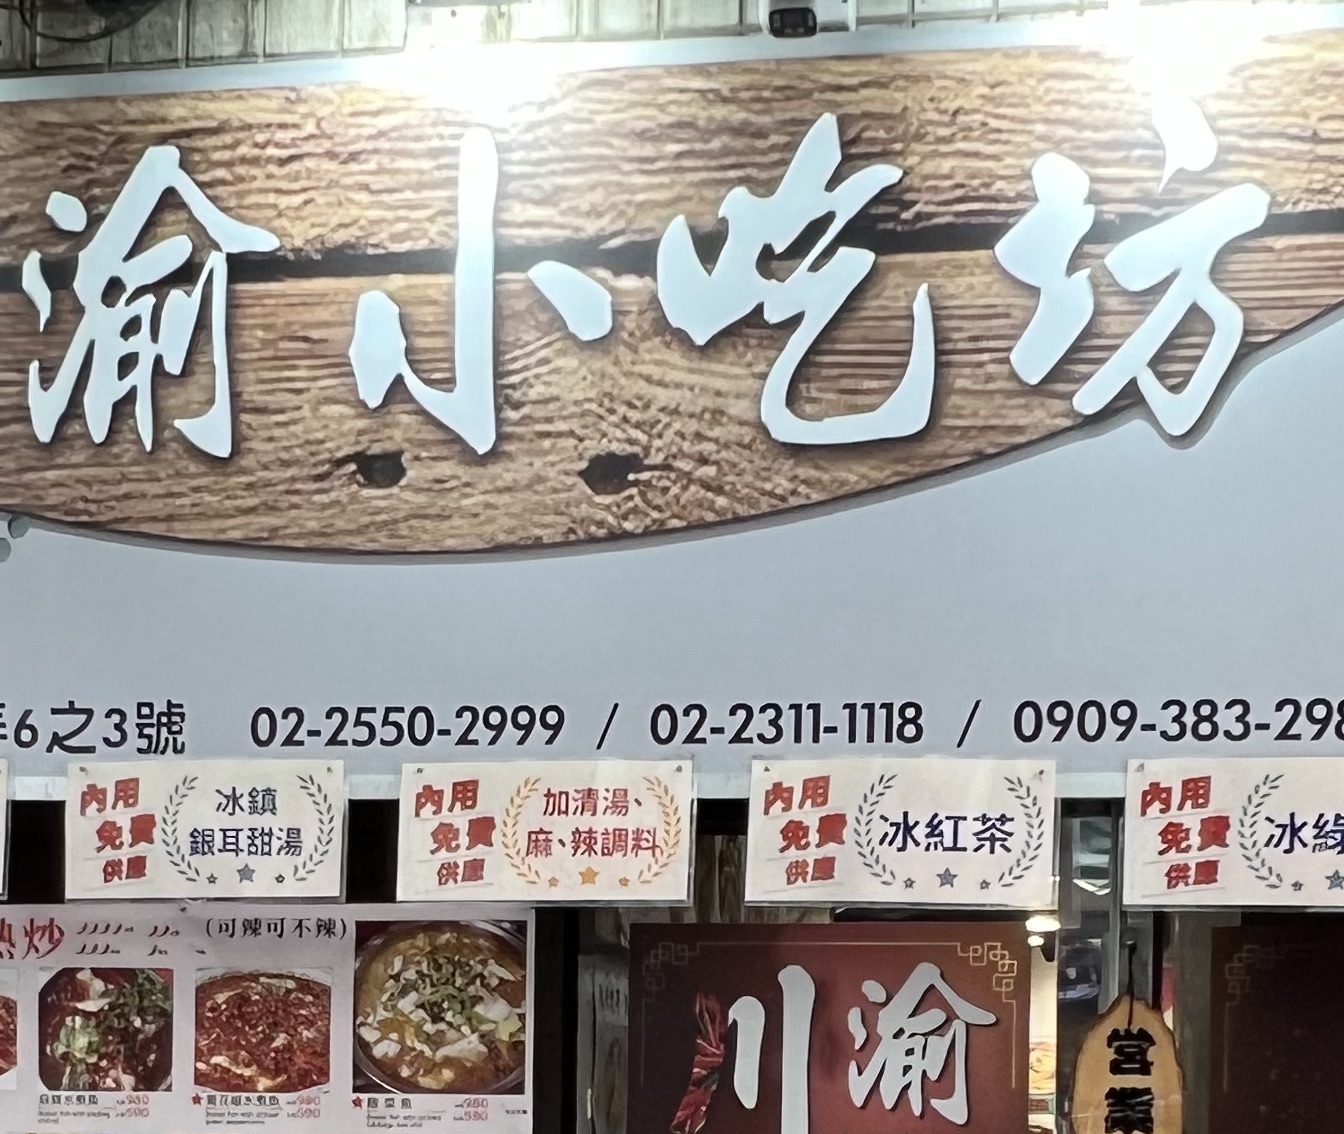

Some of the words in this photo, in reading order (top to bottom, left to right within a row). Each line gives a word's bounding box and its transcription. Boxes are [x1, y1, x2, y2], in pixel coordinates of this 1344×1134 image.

[250, 702, 566, 749] 02-2550-2999
[650, 700, 924, 747] 02-2311-1118
[79, 778, 141, 817] 內用
[214, 786, 279, 818] 冰鎮
[413, 779, 480, 818] 內用
[762, 775, 832, 815] 內用
[1139, 774, 1213, 814] 內用
[94, 813, 158, 853] 免費
[188, 825, 305, 858] 銀耳甜湯
[428, 814, 497, 856] 免費
[779, 812, 847, 852] 免費
[877, 811, 1016, 854] 冰紅茶
[1156, 814, 1232, 856] 免費
